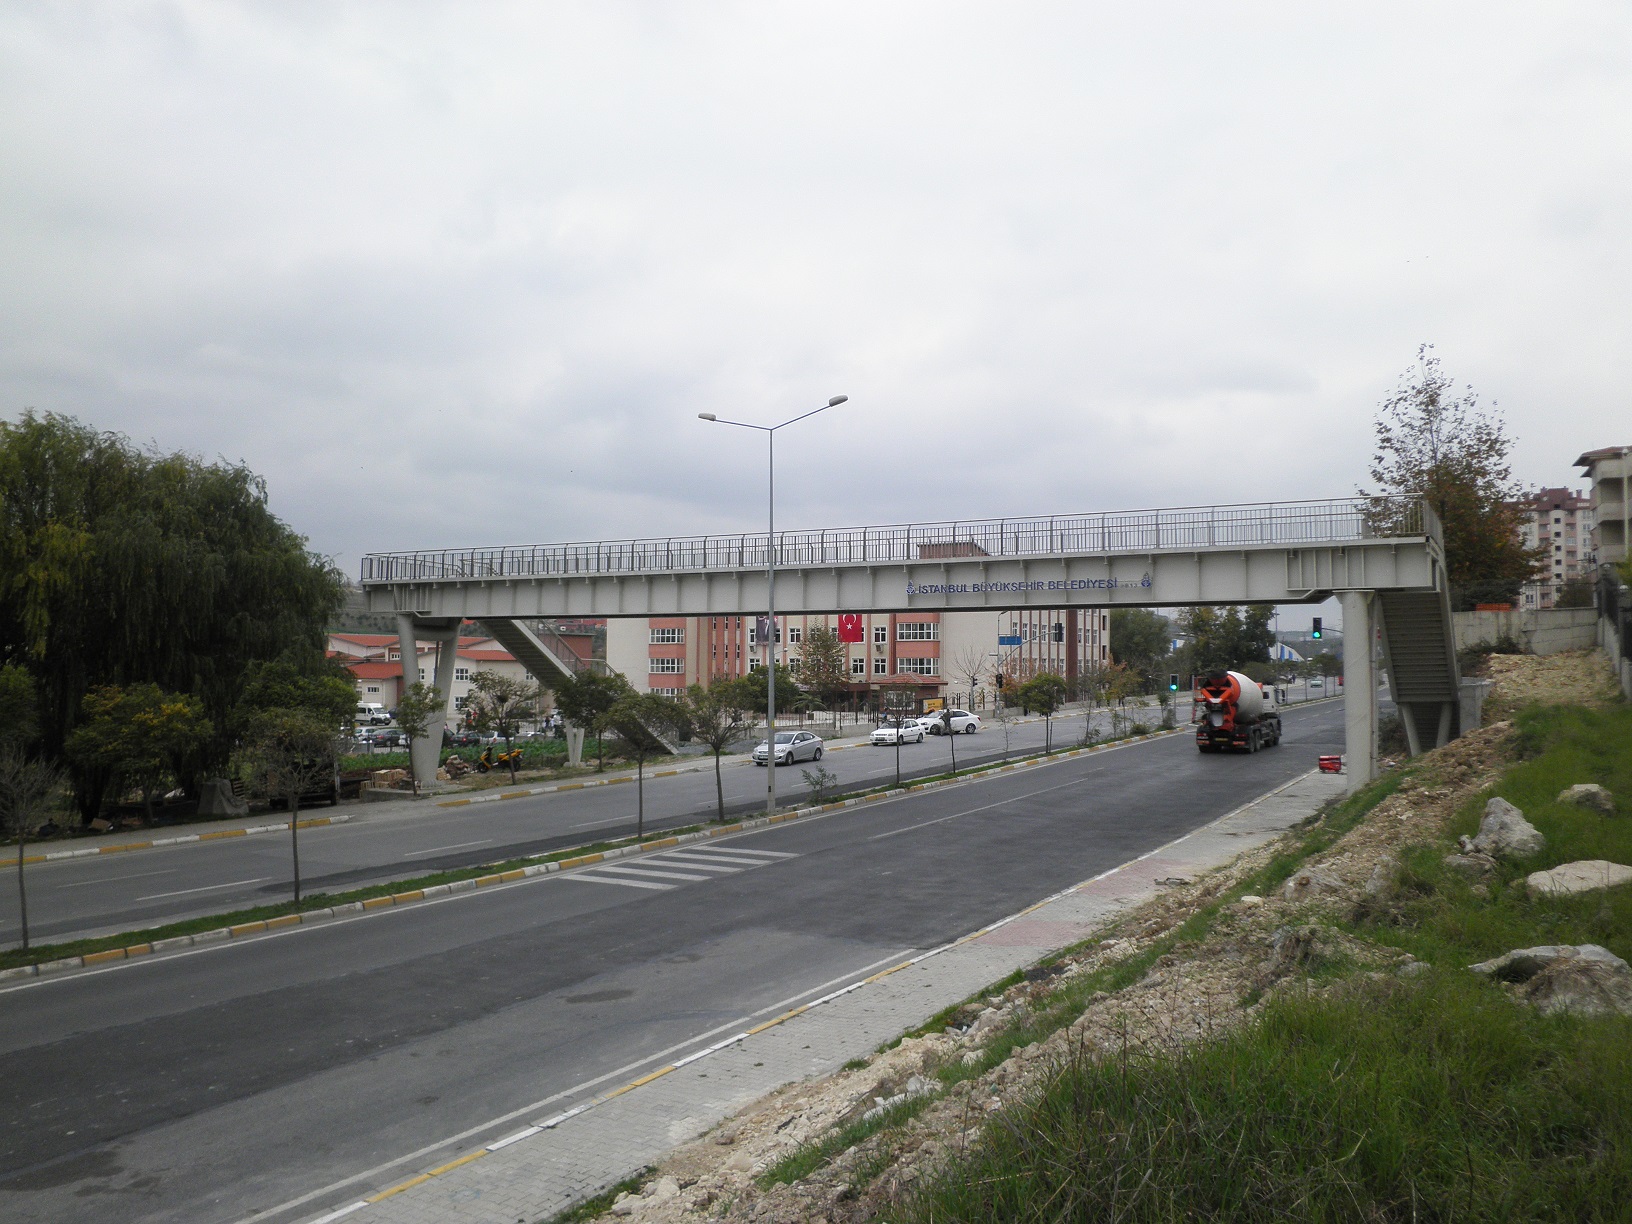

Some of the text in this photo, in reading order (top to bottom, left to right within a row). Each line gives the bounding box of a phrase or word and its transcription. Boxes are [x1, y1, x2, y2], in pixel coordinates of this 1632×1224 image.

[918, 583, 970, 594] İSTANBUL
[972, 580, 1044, 593] BÜYÜKŞEHİR
[1047, 577, 1118, 590] BELEDİYESİ
